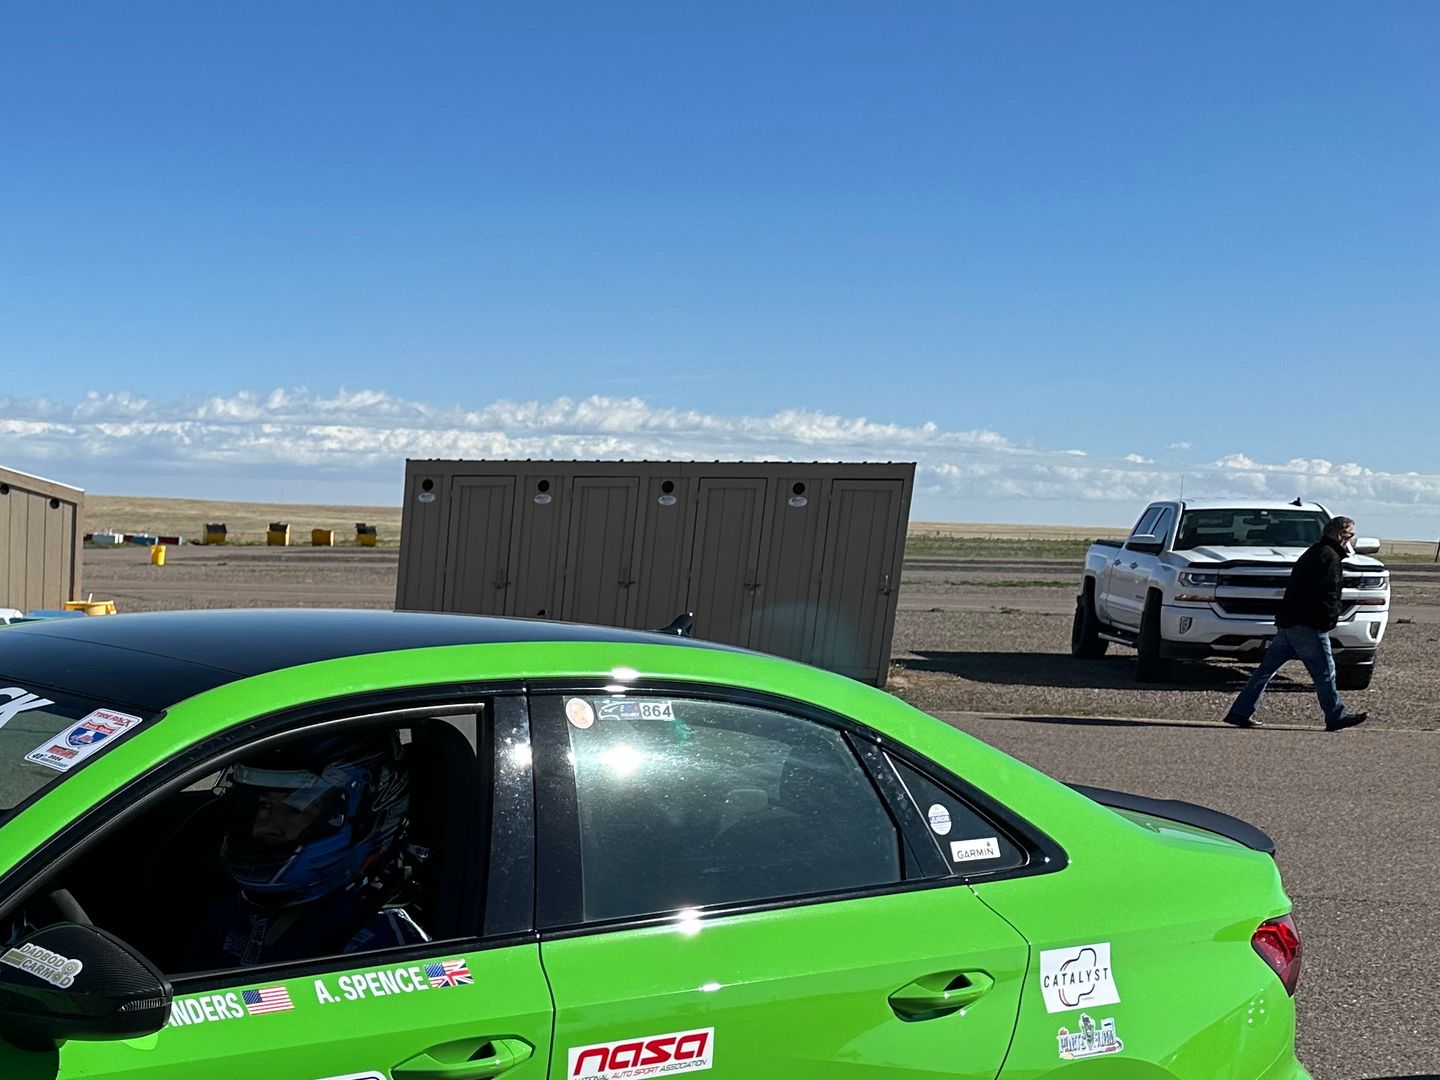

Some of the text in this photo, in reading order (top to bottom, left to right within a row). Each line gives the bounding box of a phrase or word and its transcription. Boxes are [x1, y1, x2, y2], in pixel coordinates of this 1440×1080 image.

[642, 705, 671, 717] 864
[957, 847, 994, 859] GARMIN
[21, 944, 65, 968] DADBOD
[314, 966, 429, 1004] A. SPENCE
[1043, 967, 1108, 988] CATALYST
[611, 1070, 632, 1079] AUTO
[633, 1066, 660, 1076] SPORT
[659, 1059, 707, 1072] ASSOCIATION
